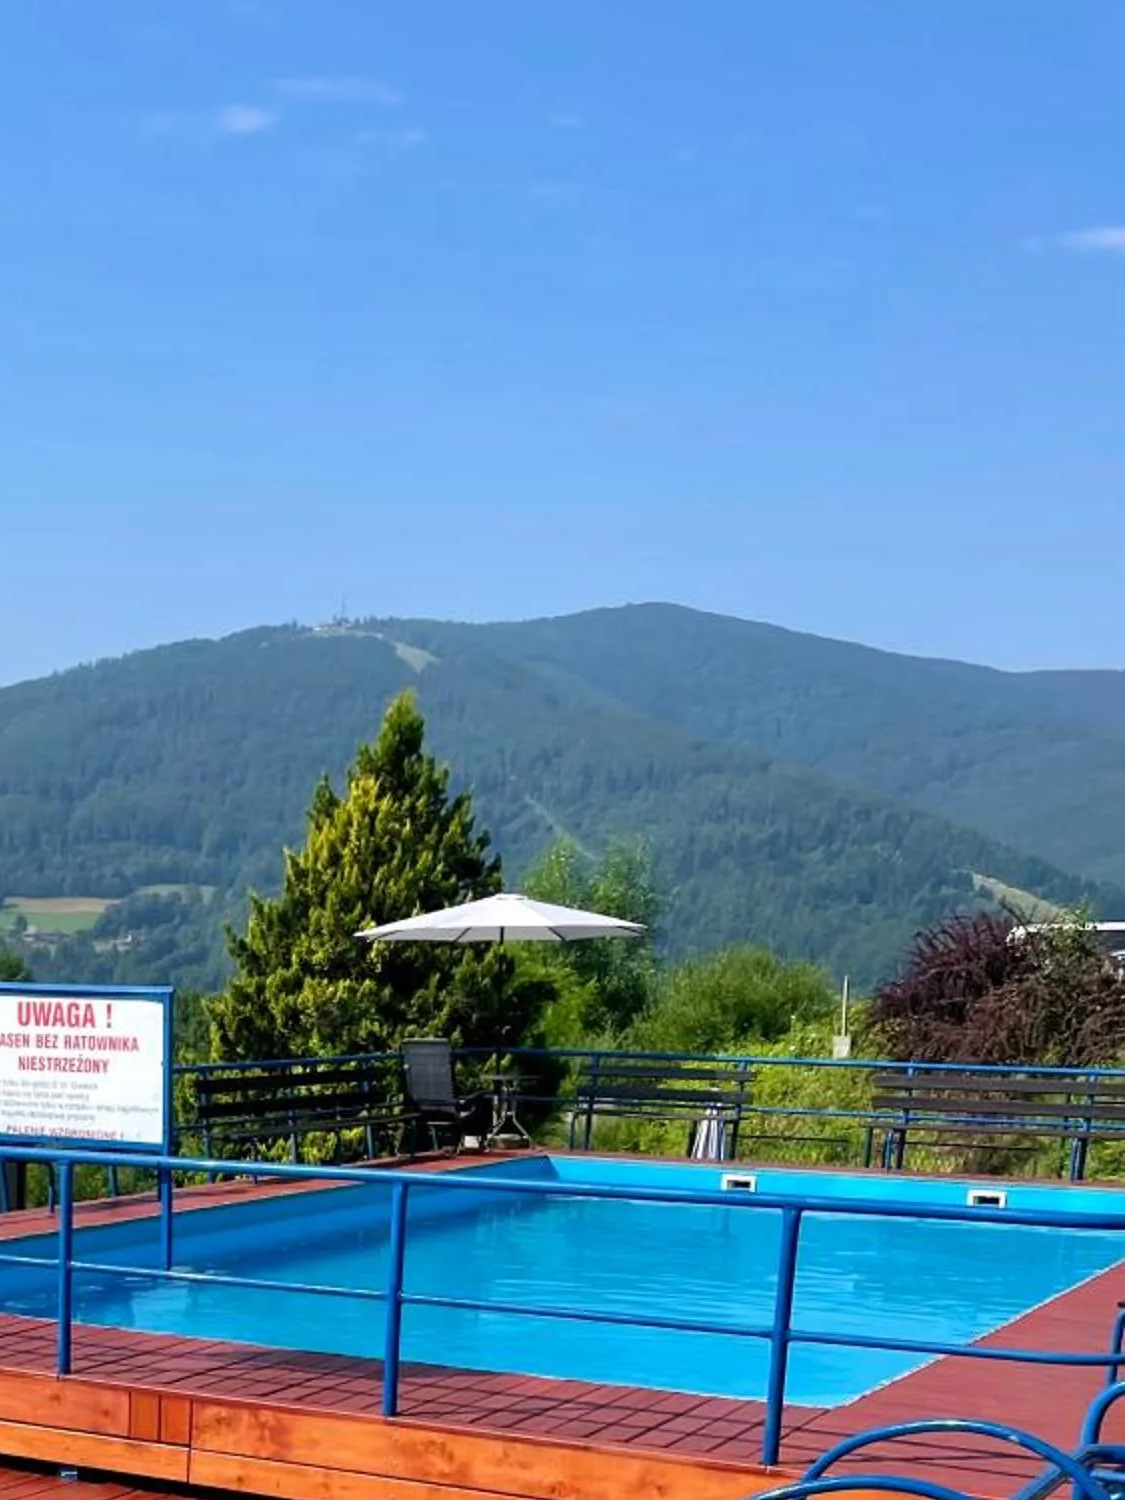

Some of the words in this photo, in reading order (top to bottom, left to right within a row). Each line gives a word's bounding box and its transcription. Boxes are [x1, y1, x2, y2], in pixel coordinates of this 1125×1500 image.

[17, 1002, 96, 1029] UWAGA
[106, 1003, 113, 1028] !
[36, 1034, 59, 1050] BEZ
[64, 1034, 139, 1051] RATOWNIKA
